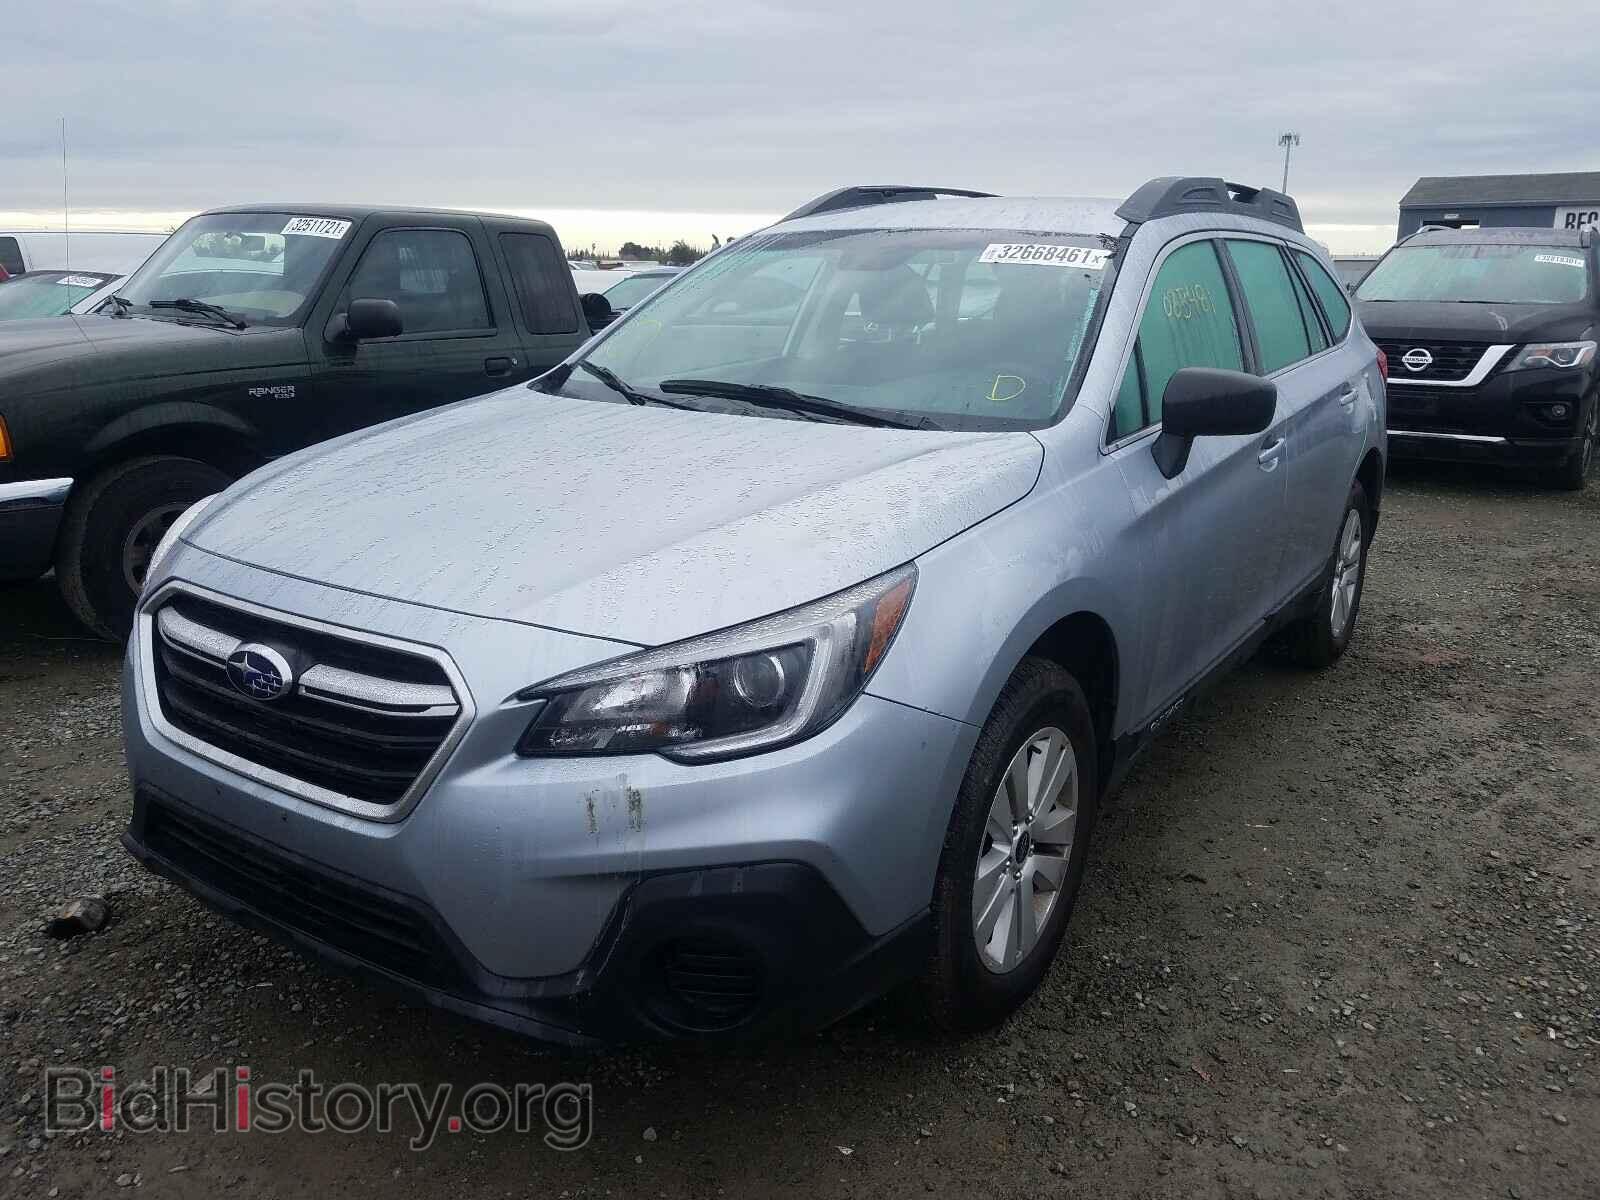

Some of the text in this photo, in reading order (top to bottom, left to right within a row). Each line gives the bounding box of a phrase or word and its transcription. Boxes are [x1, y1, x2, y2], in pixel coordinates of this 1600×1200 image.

[291, 218, 341, 234] 32511721
[997, 244, 1092, 264] 32668461
[248, 385, 296, 397] RANGER
[985, 374, 1026, 401] D
